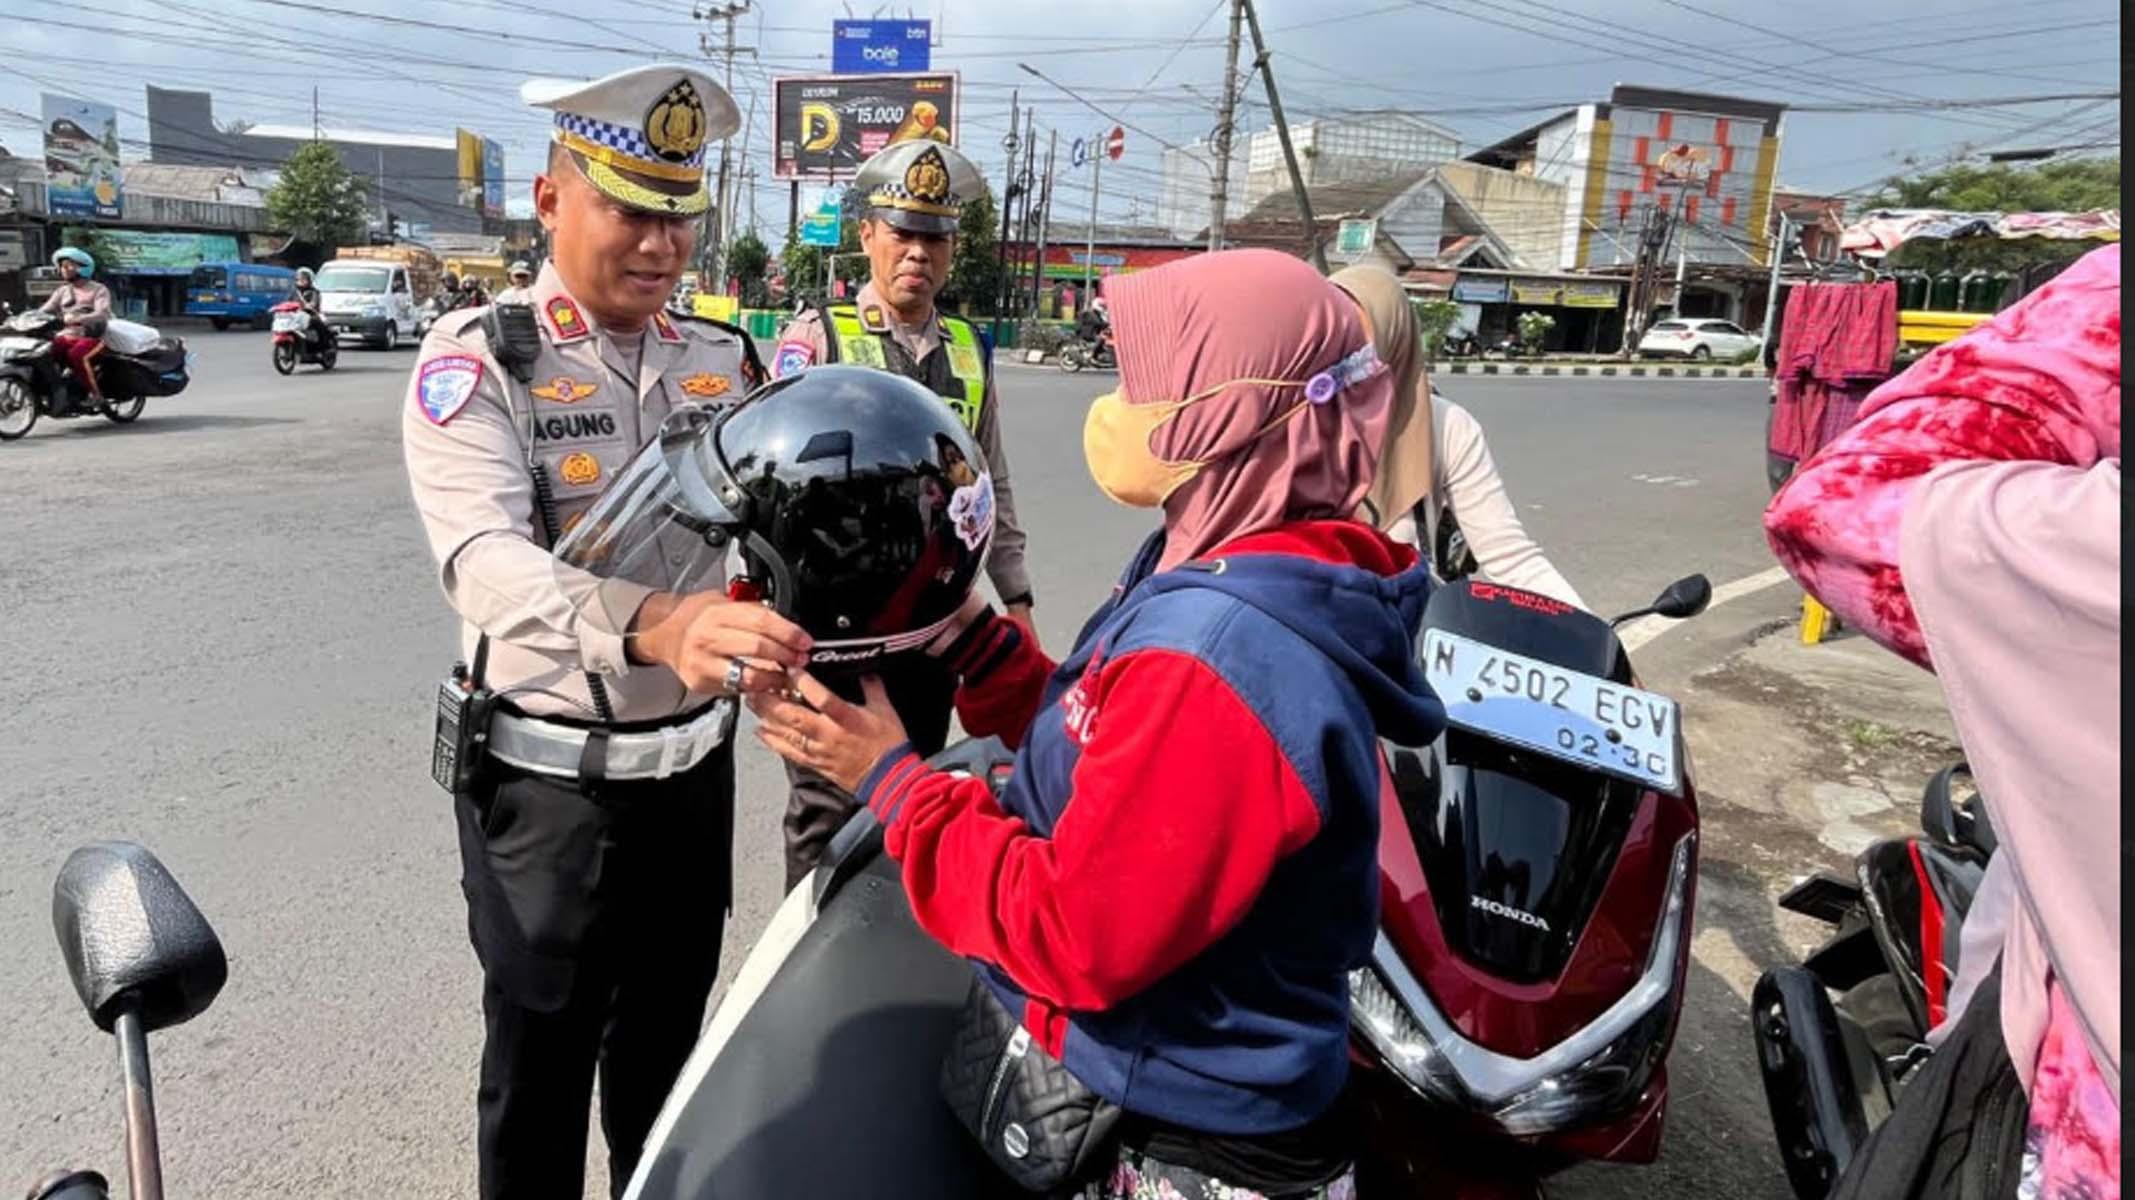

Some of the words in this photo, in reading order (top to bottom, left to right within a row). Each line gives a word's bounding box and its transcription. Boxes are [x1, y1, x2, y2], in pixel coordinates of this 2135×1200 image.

[906, 27, 927, 39] btn
[863, 45, 899, 61] bale
[533, 413, 616, 441] AGUNG
[1434, 639, 1455, 677] N
[1477, 656, 1571, 711] 4502
[1595, 686, 1668, 738] EGV
[1470, 894, 1551, 932] HONDA
